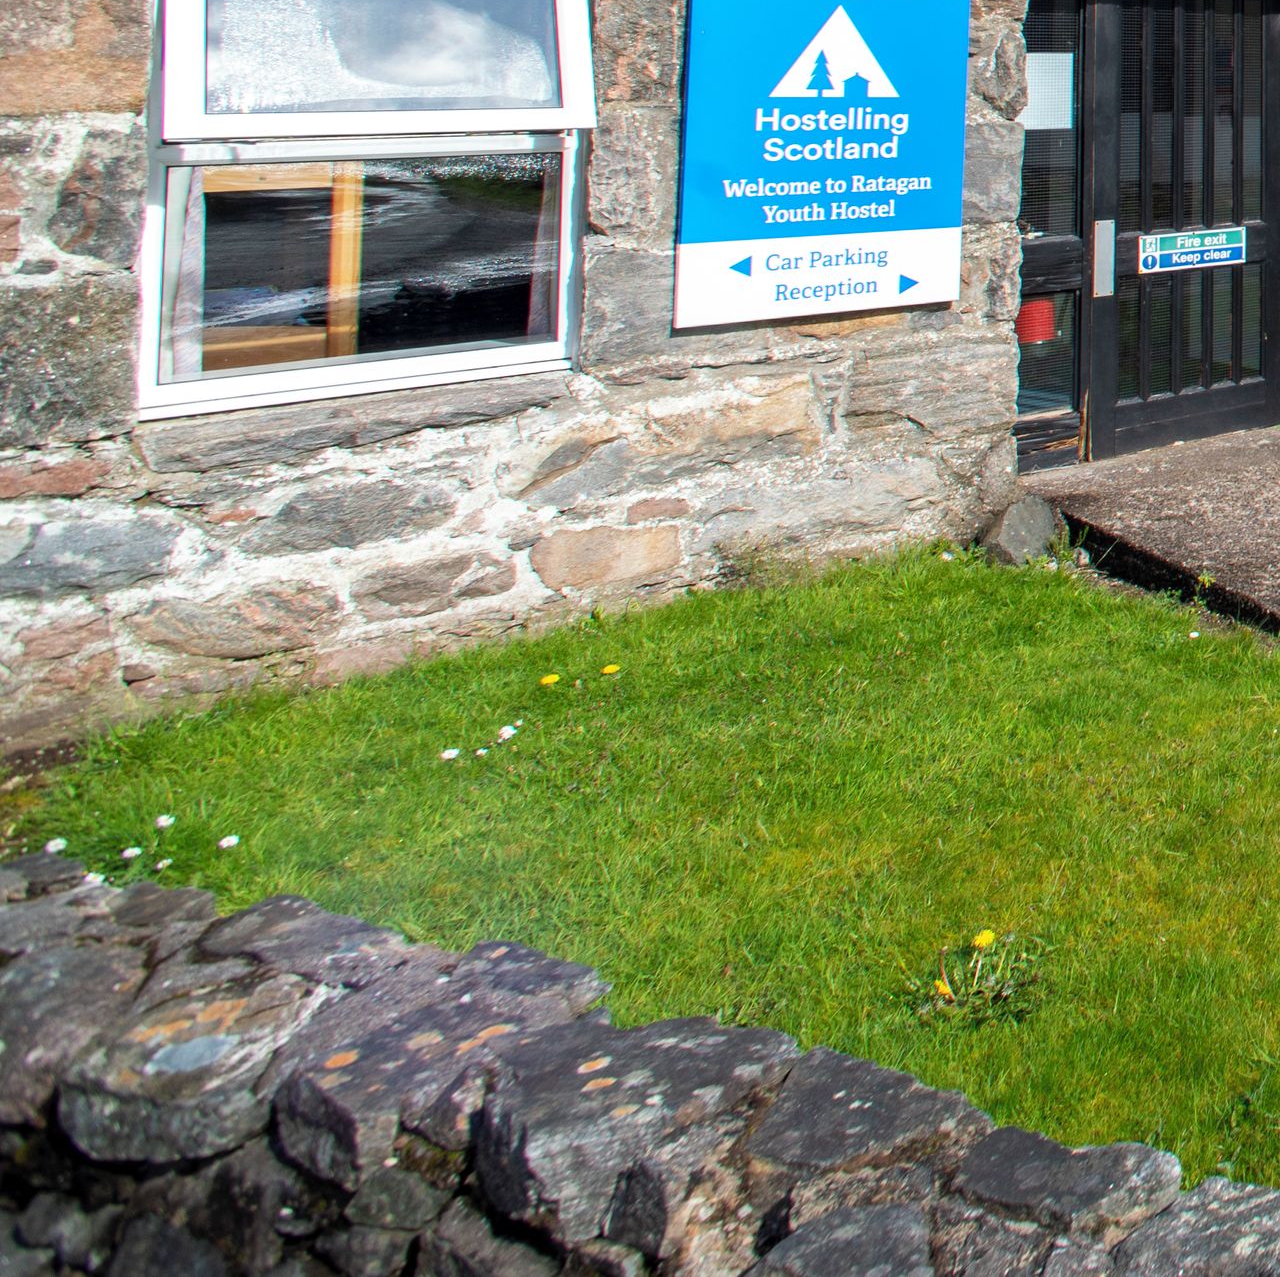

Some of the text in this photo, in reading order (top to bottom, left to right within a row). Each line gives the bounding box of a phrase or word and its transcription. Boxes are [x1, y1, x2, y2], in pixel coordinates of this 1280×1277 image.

[755, 107, 909, 135] Hostelling
[763, 136, 899, 161] Scotland
[722, 175, 932, 198] Welcome to Ratagan
[762, 199, 896, 224] Youth Hostel
[1176, 234, 1227, 248] Fire exit
[765, 247, 888, 271] Car Parking
[1172, 249, 1232, 265] Keep clear
[775, 278, 877, 302] Reception
